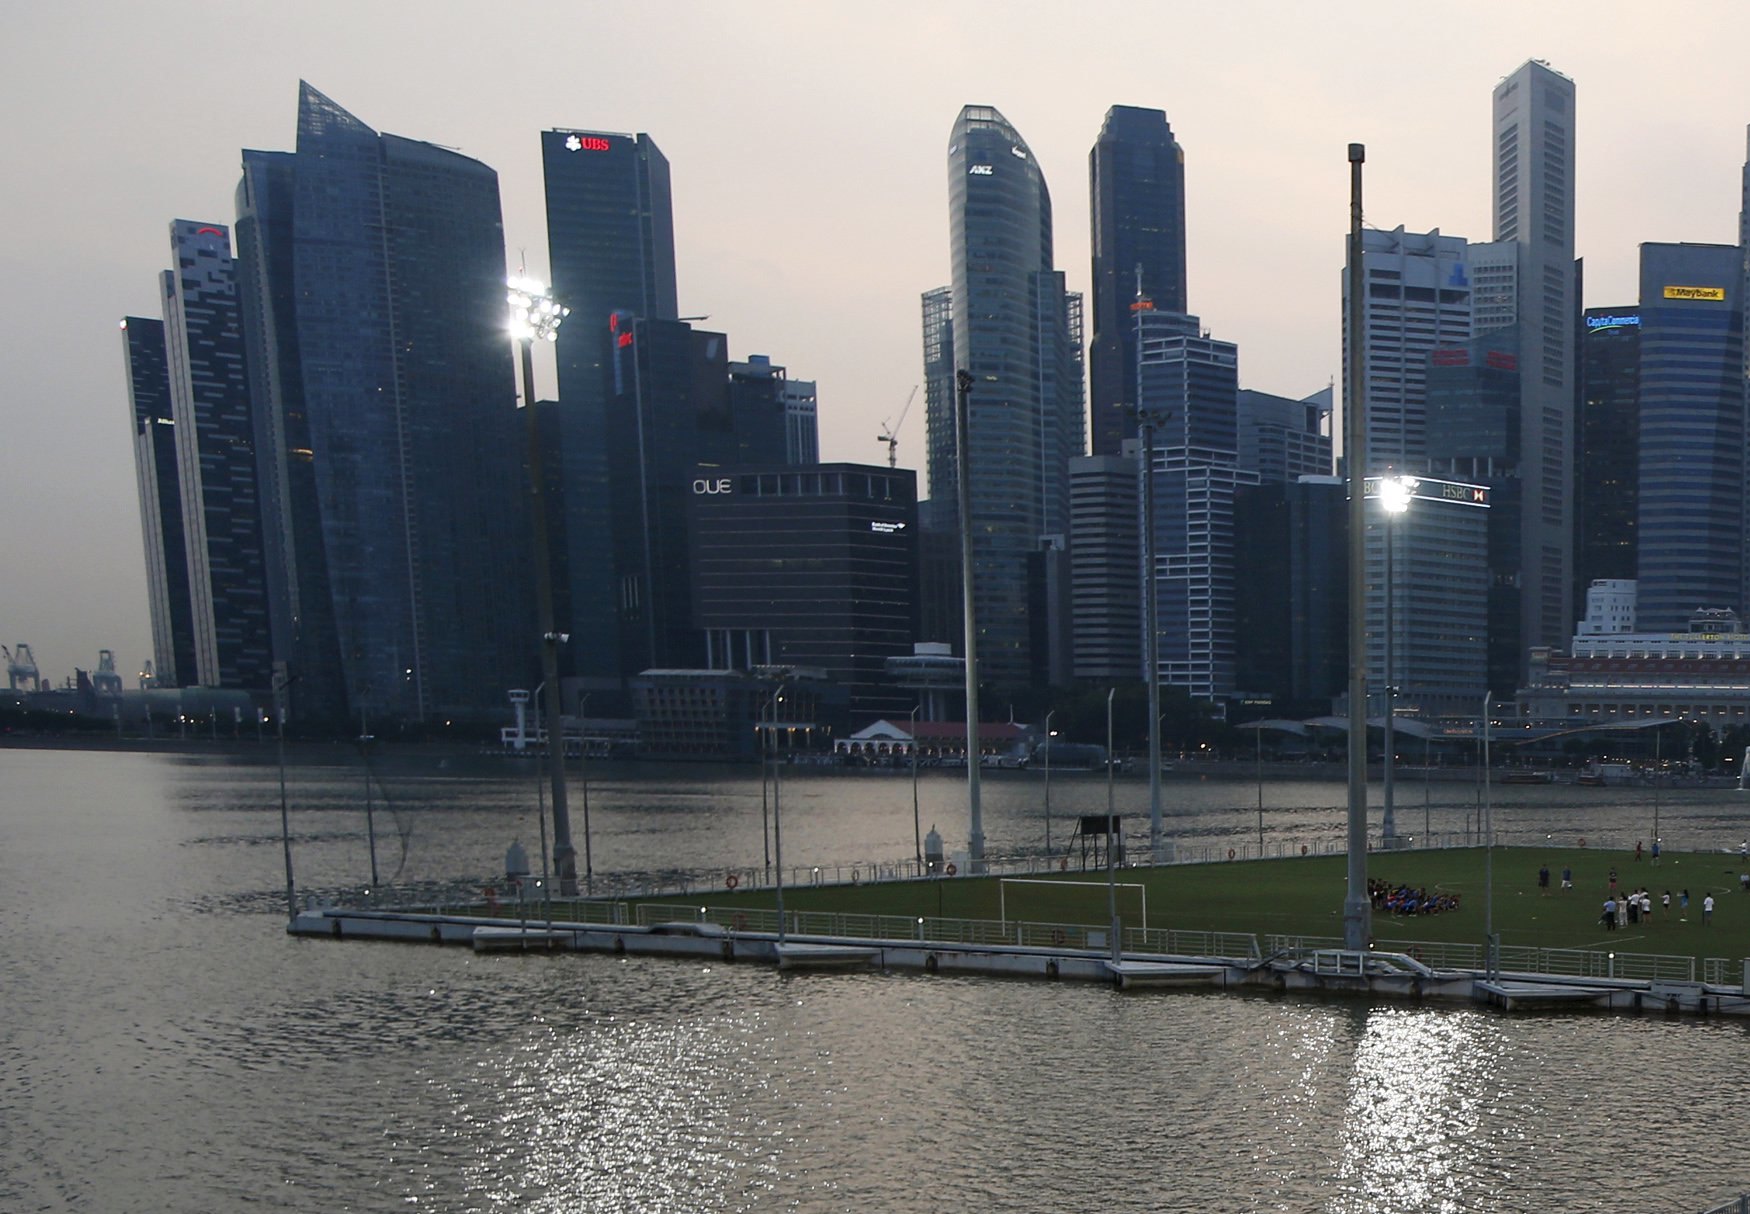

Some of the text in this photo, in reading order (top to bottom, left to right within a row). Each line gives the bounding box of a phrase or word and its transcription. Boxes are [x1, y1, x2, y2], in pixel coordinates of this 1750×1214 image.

[581, 137, 609, 151] UBS
[1676, 287, 1719, 299] Maybank
[693, 479, 732, 494] OUE
[1442, 484, 1471, 500] HSBC
